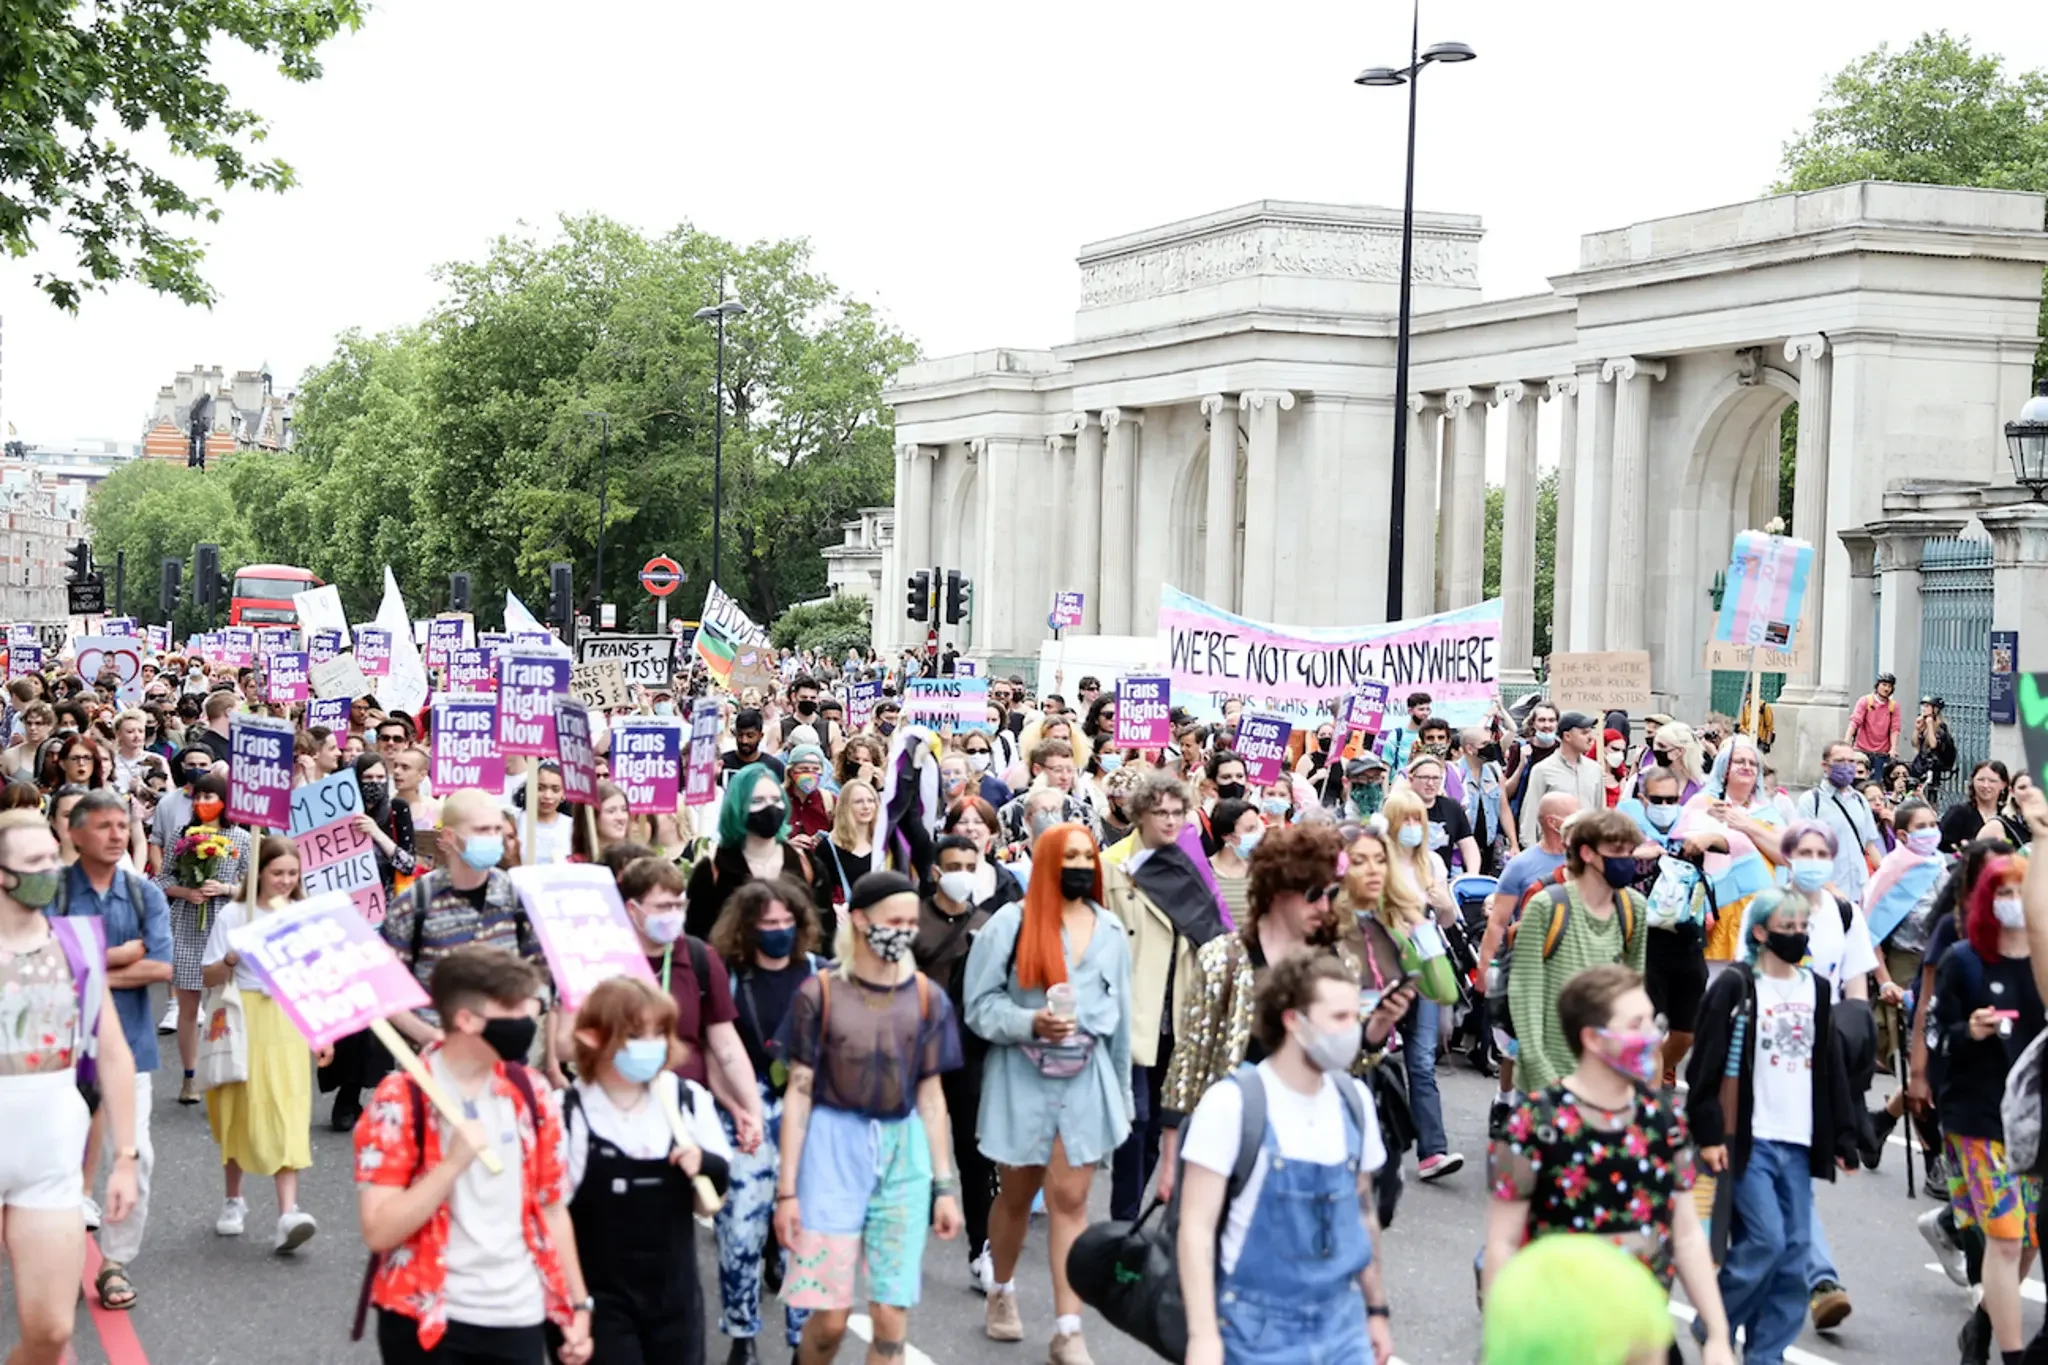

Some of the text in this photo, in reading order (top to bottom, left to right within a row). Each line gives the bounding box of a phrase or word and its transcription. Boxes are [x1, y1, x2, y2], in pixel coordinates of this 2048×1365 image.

[430, 620, 457, 635] Trans
[512, 633, 544, 646] Trans
[431, 635, 462, 651] Rights
[269, 653, 299, 668] Trans
[450, 650, 482, 663] Trans
[1171, 625, 1494, 688] WE'RE NOT GOING ANYWHERE
[271, 667, 306, 687] Rights
[452, 664, 488, 682] Rights
[501, 658, 555, 686] Trans
[271, 685, 296, 699] Now
[850, 684, 875, 697] Trans
[912, 682, 962, 698] TRANS
[1117, 679, 1159, 698] Trans
[1355, 682, 1382, 698] Trans
[310, 700, 342, 716] Trans
[501, 686, 555, 721] Right
[1119, 699, 1168, 723] Rights
[1353, 696, 1384, 714] Rights
[435, 705, 491, 731] Trans
[500, 715, 544, 745] Now
[1241, 716, 1280, 739] Trans
[1350, 712, 1371, 726] Now
[231, 724, 280, 759] Trans
[613, 728, 665, 752] Trans
[1119, 721, 1152, 740] Now
[438, 732, 503, 763] Rights
[1236, 736, 1283, 760] Rights
[232, 753, 290, 791] Rights
[437, 759, 481, 785] Now
[615, 753, 677, 783] Rights
[231, 783, 270, 815] Now
[320, 781, 356, 818] SO
[297, 823, 367, 866] IRED
[304, 855, 373, 896] F THIS
[258, 917, 346, 970] Trans
[271, 940, 389, 1000] Rights
[295, 981, 378, 1033] Now
